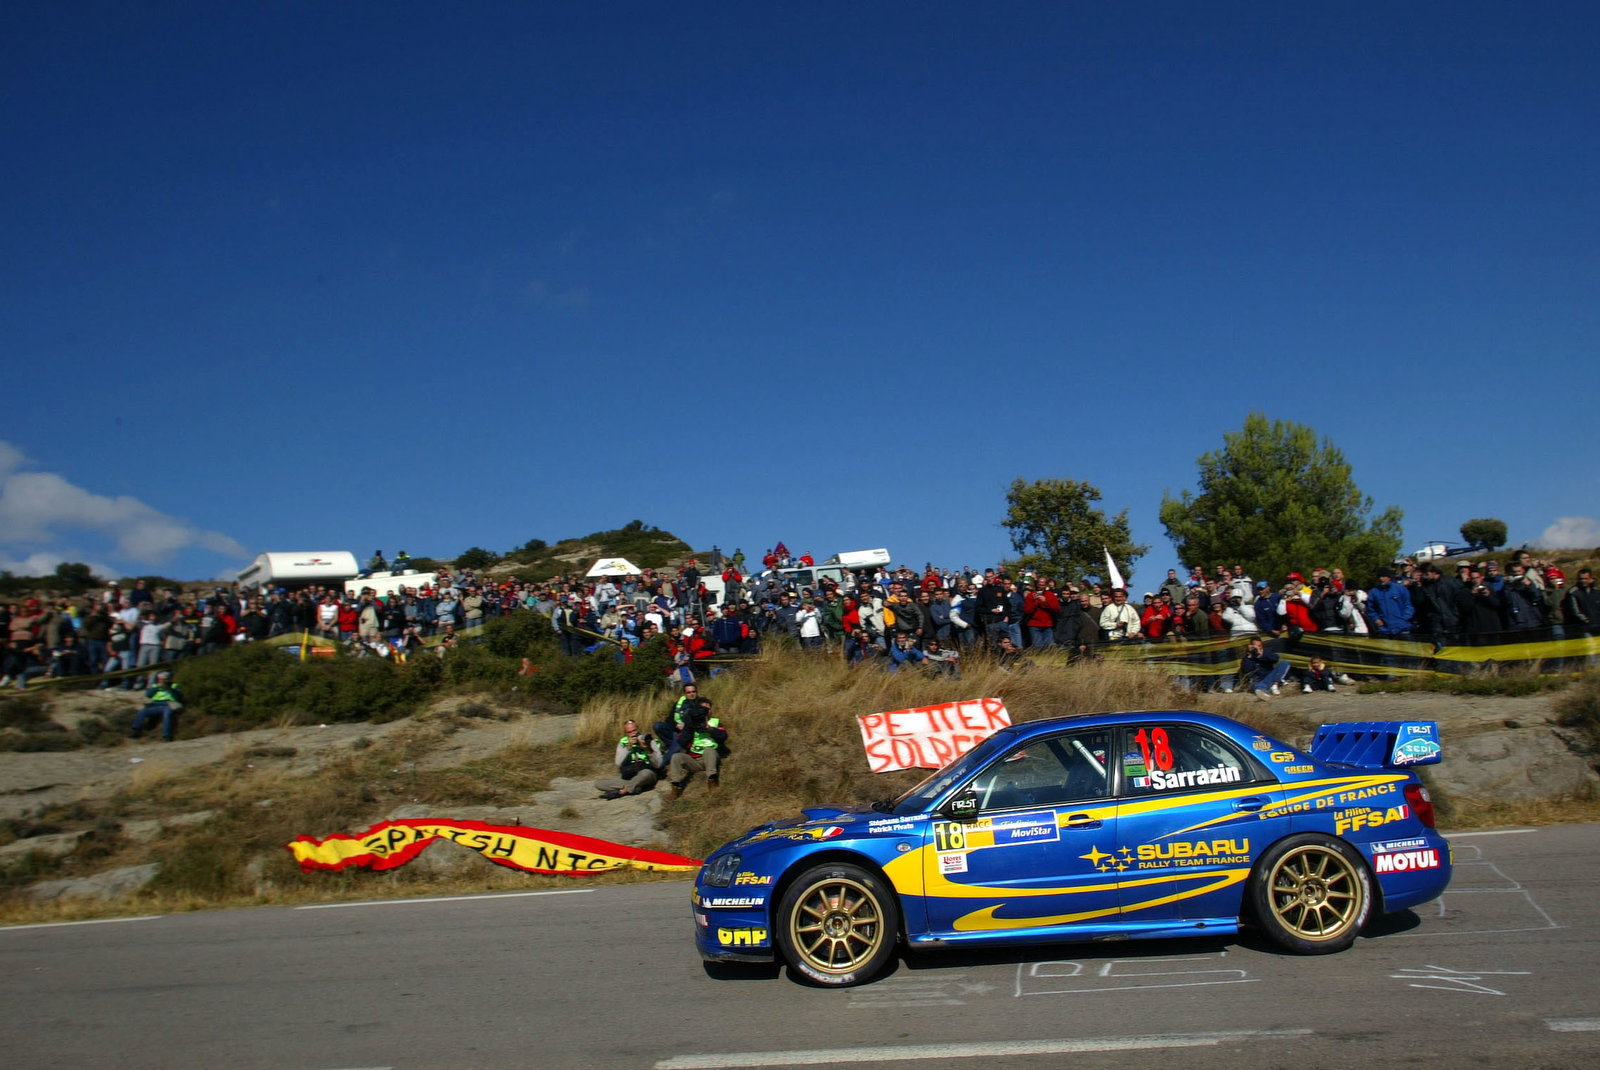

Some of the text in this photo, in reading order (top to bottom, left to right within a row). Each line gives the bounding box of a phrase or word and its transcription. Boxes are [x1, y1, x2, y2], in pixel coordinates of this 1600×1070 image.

[860, 697, 1012, 740] PETTER
[1407, 725, 1432, 735] FIRST
[1134, 728, 1174, 771] 18
[1405, 744, 1431, 752] SEDI
[1152, 764, 1241, 790] Sarrazin
[952, 799, 976, 812] FIRST
[1259, 783, 1397, 820] EQUIPE DE FRANCE
[1011, 826, 1052, 838] MoviStar
[1336, 808, 1402, 836] FFSA
[935, 823, 965, 850] 18
[1386, 839, 1424, 849] MICHELIN
[1137, 838, 1250, 861] SUBARU
[1138, 855, 1250, 869] RALLY TEAM FRANCE
[1376, 850, 1438, 873] MOTUL
[735, 876, 767, 886] FFSA
